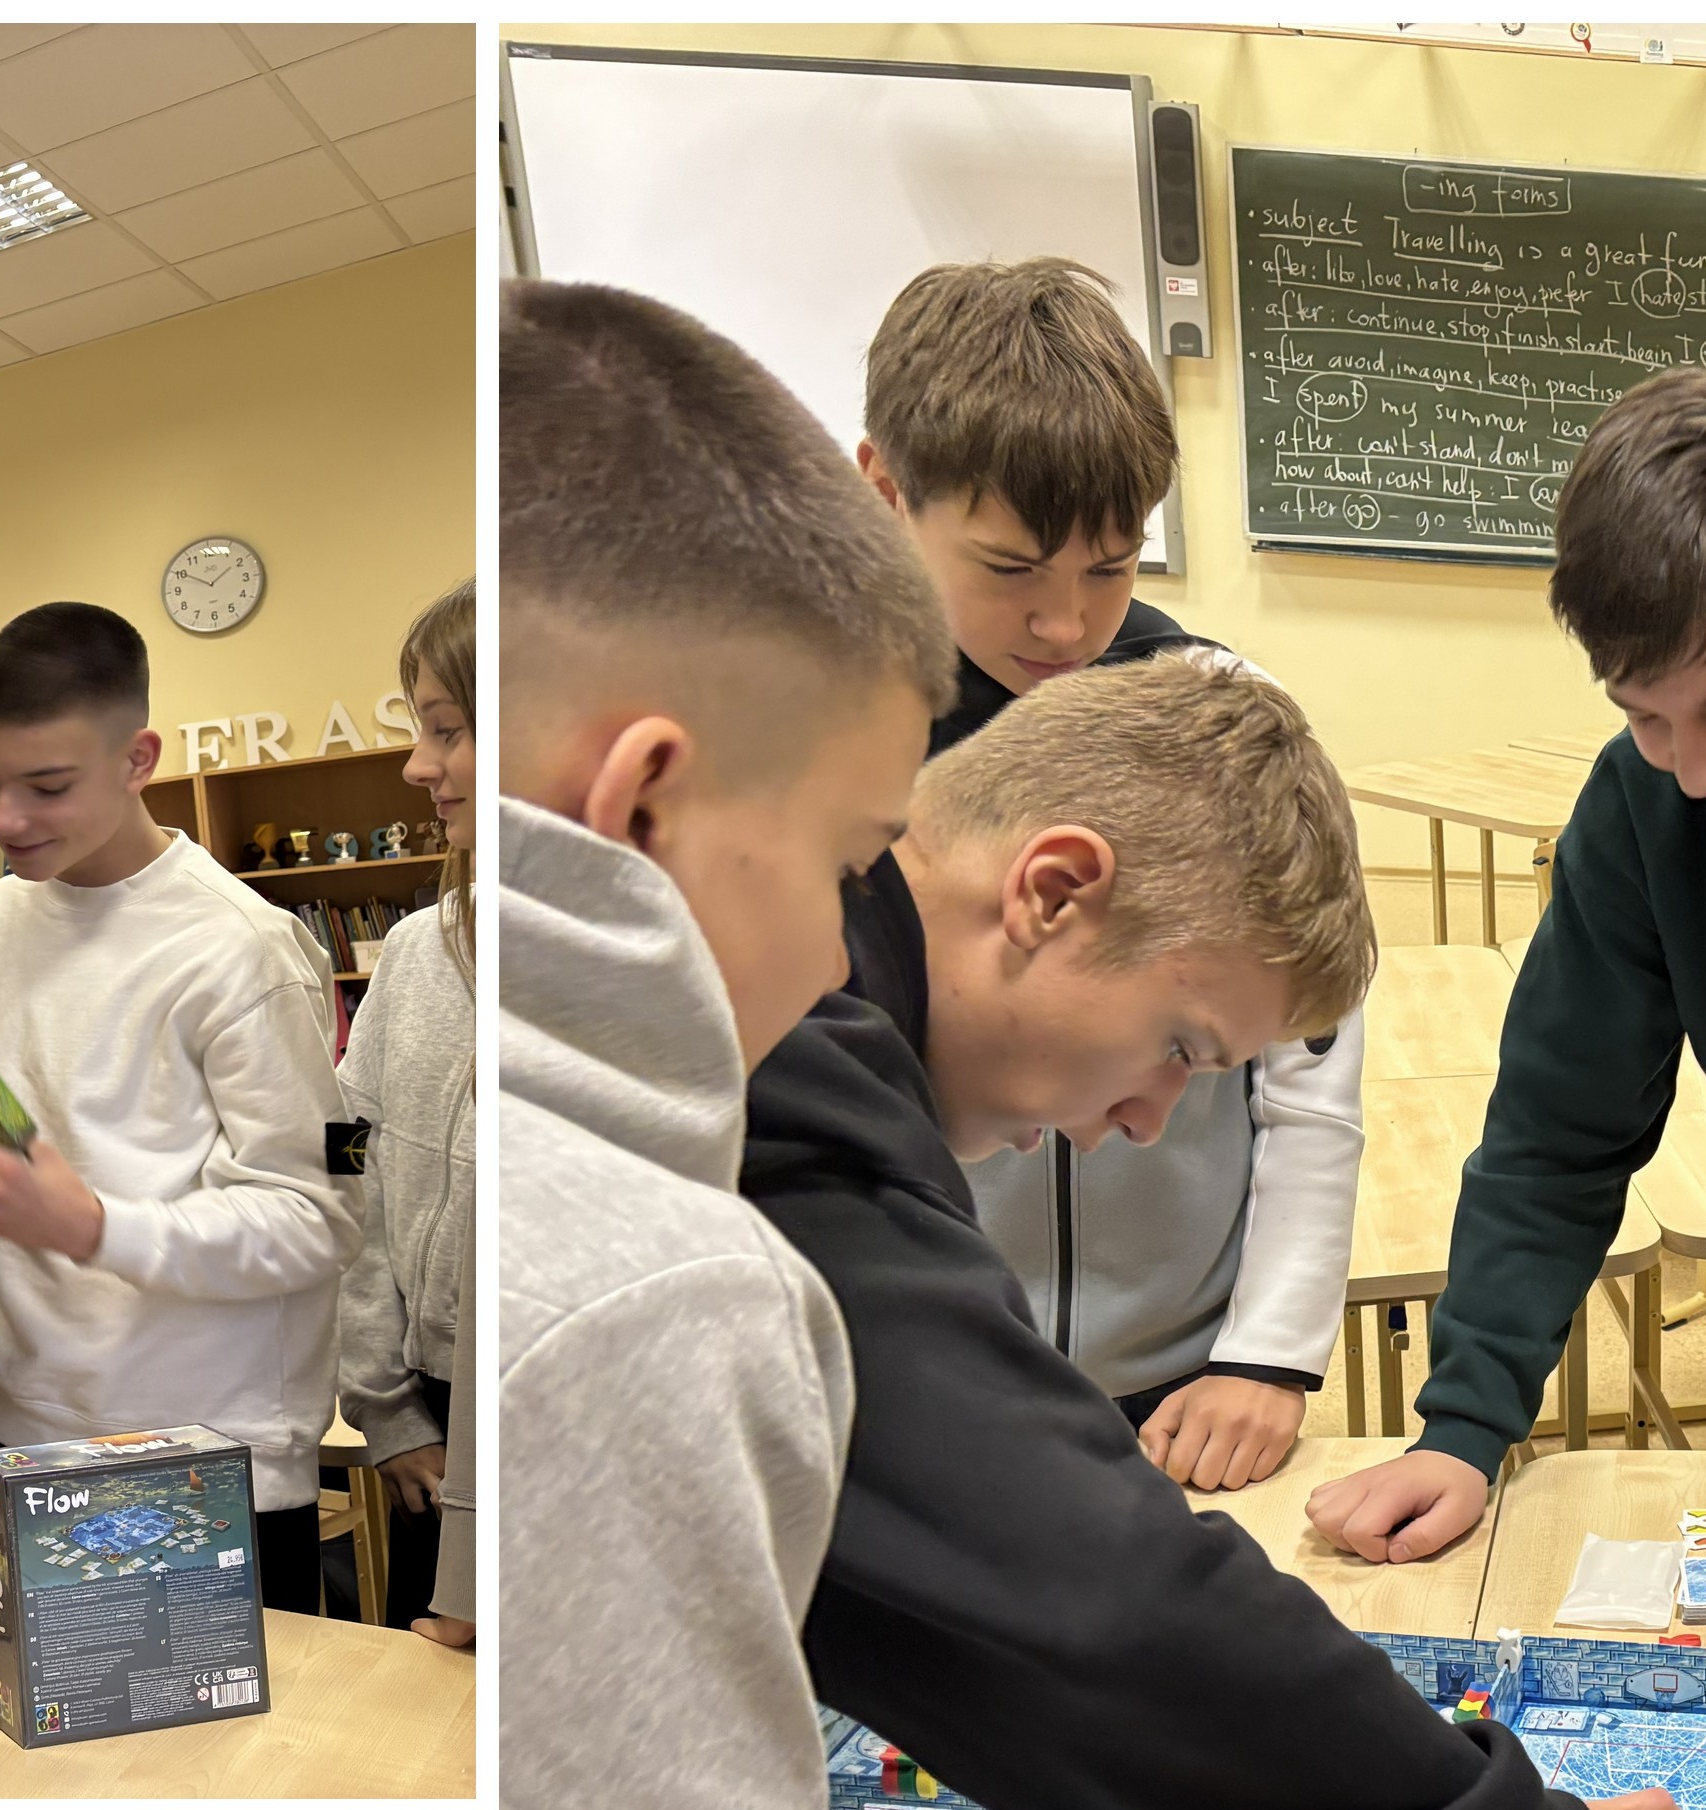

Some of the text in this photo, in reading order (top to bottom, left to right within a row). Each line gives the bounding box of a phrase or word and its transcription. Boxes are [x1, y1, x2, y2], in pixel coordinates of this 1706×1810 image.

[1263, 199, 1358, 247] subject
[1383, 216, 1504, 271] Travelling
[1561, 246, 1572, 258] a
[1585, 233, 1653, 276] great
[1605, 281, 1628, 305] I
[1381, 397, 1418, 427] my
[1436, 405, 1528, 433] summer
[1274, 451, 1315, 480] how
[1416, 511, 1446, 537] go
[69, 1437, 174, 1458] Flow
[23, 1486, 90, 1516] Flow
